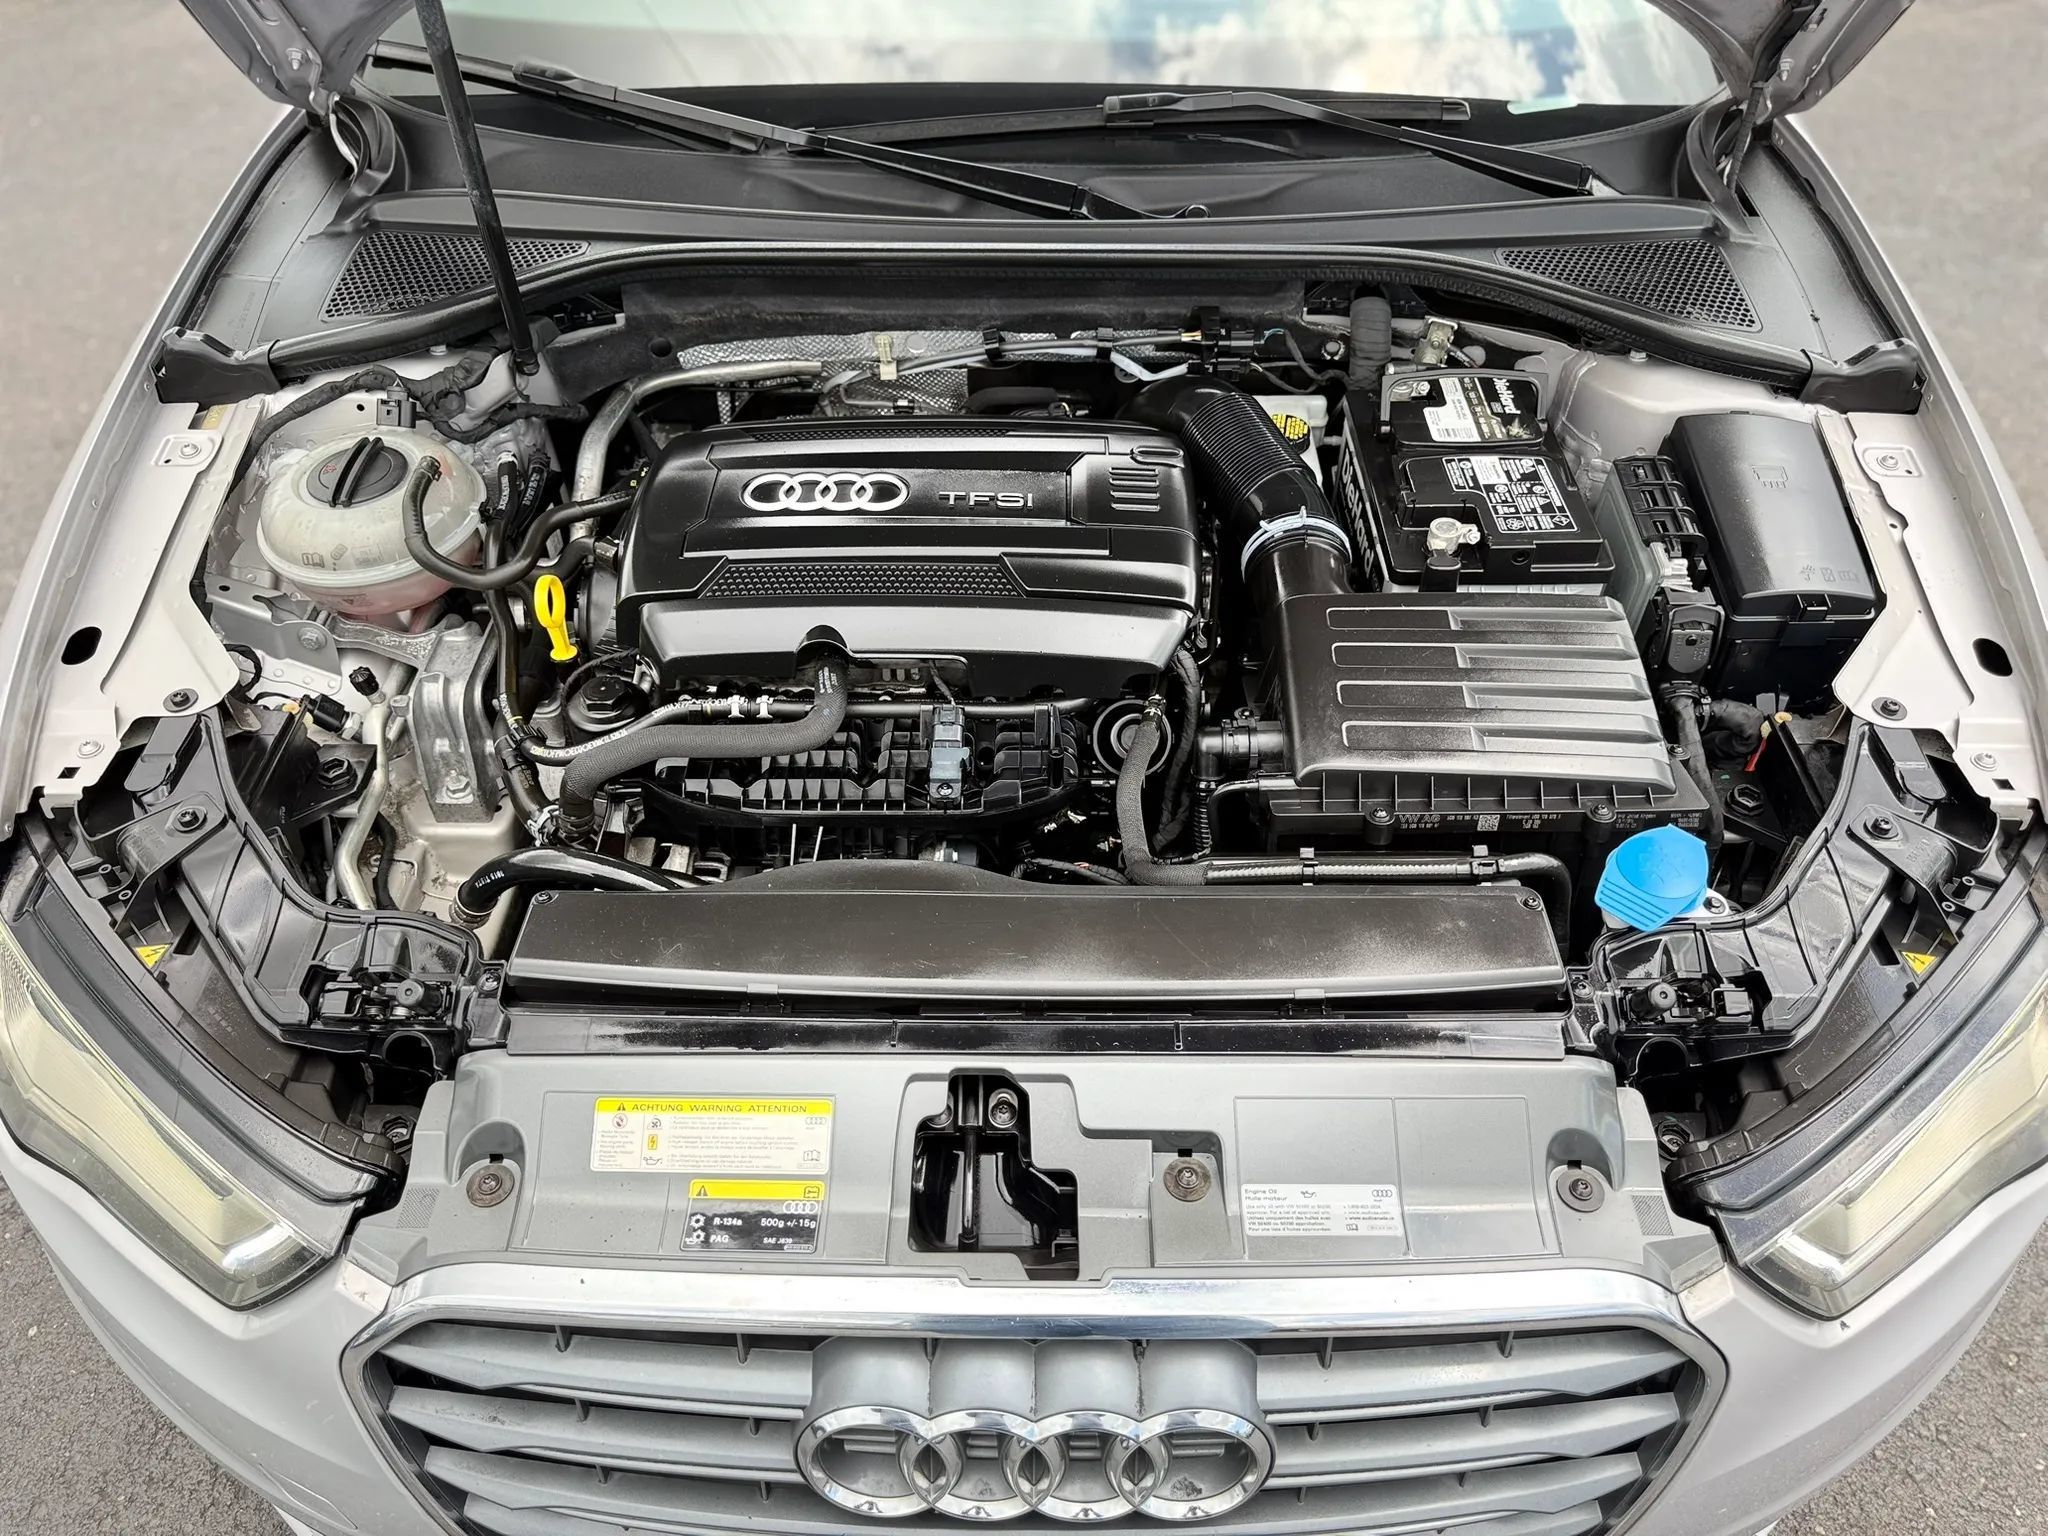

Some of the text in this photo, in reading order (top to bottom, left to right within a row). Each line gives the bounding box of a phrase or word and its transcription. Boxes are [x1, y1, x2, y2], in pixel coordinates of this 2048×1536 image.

[938, 491, 1034, 508] TFSI
[1342, 448, 1375, 579] DieHard
[1399, 814, 1421, 823] VW
[1421, 814, 1441, 823] AG
[631, 1103, 808, 1113] ACHTUNG WARNING ATTENTION
[712, 1217, 743, 1226] R-134a
[760, 1217, 785, 1228] 500g
[709, 1235, 730, 1243] PAG
